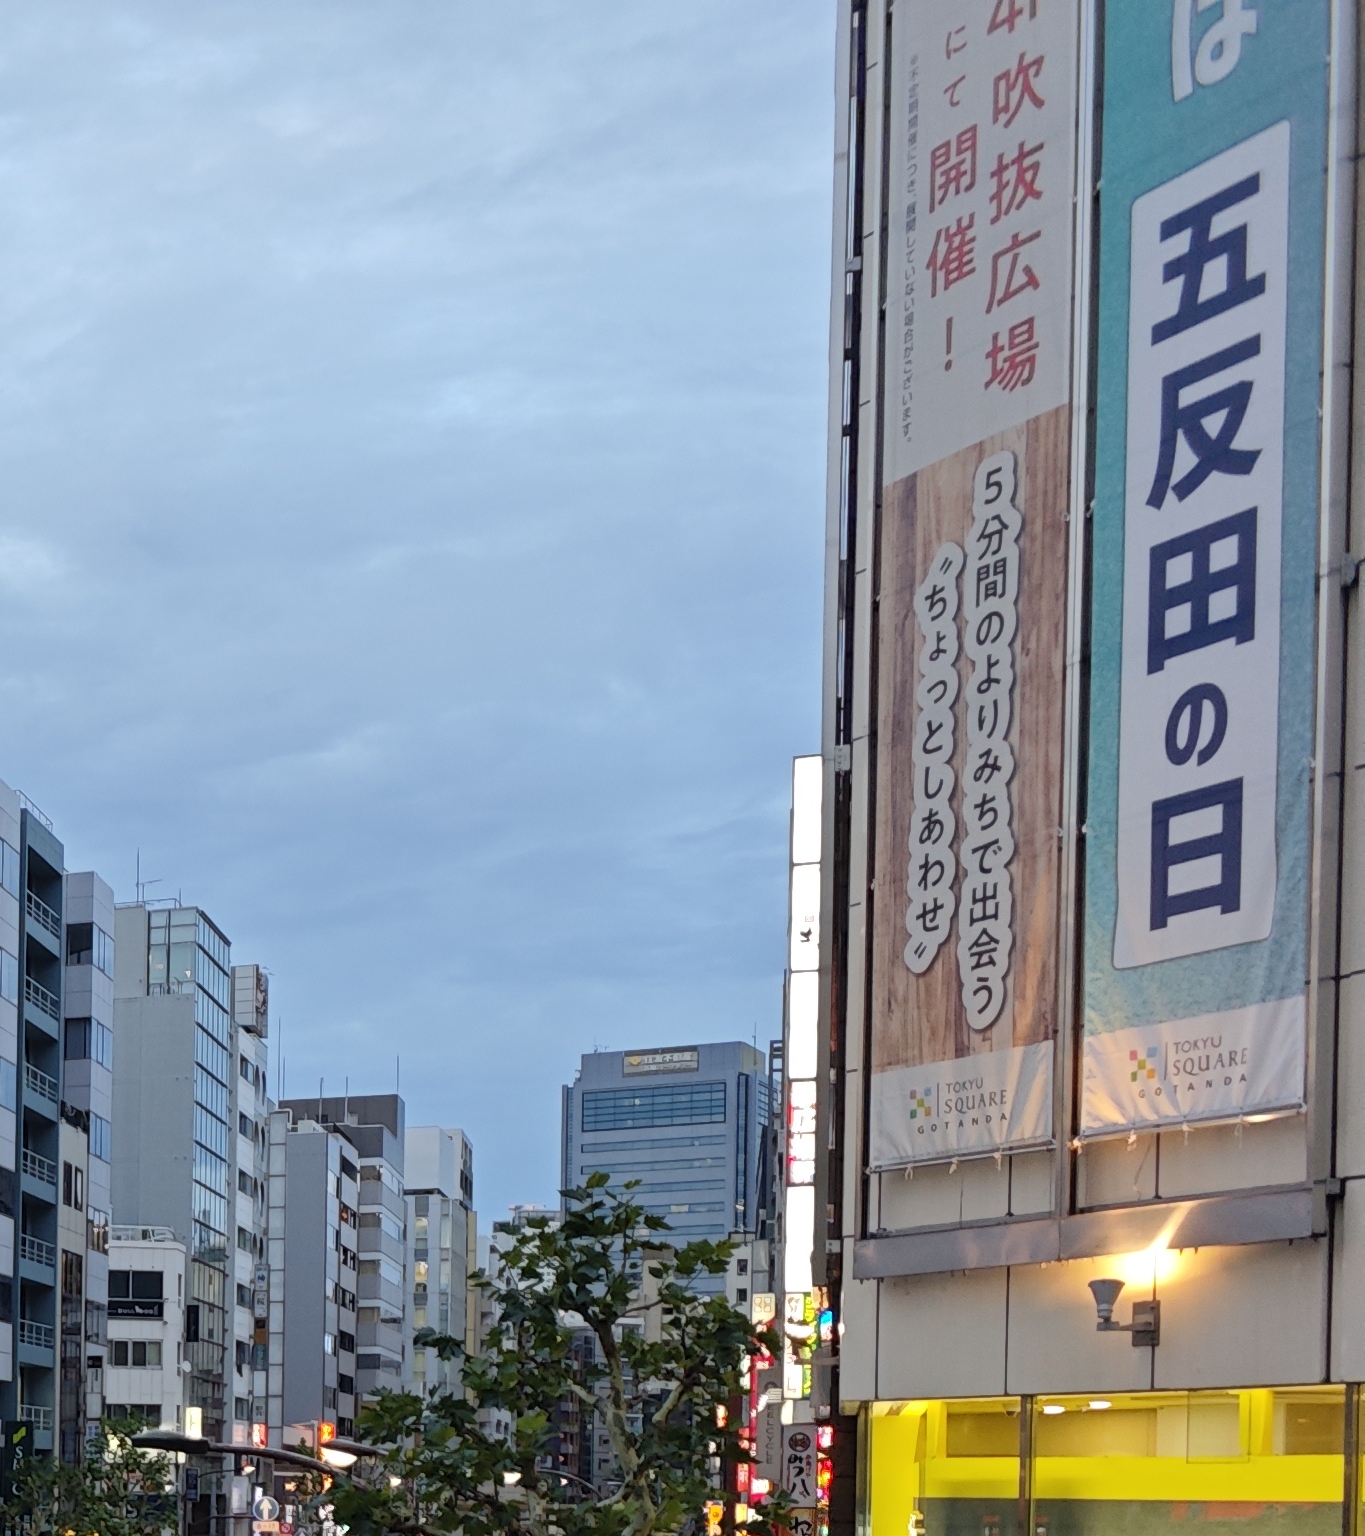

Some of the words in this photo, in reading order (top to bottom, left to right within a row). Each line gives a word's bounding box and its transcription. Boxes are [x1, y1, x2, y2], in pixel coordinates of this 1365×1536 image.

[1145, 171, 1267, 932] 五反田の日
[966, 468, 1011, 1015] 5分間のよりみちで出会う
[1173, 1035, 1223, 1052] TOKYU
[1173, 1047, 1248, 1078] SQUARE
[945, 1078, 984, 1094] TOKYU
[1138, 1076, 1248, 1098] GOTANDA
[944, 1089, 1008, 1115] SQUARE
[917, 1112, 1008, 1135] GOTANDA
